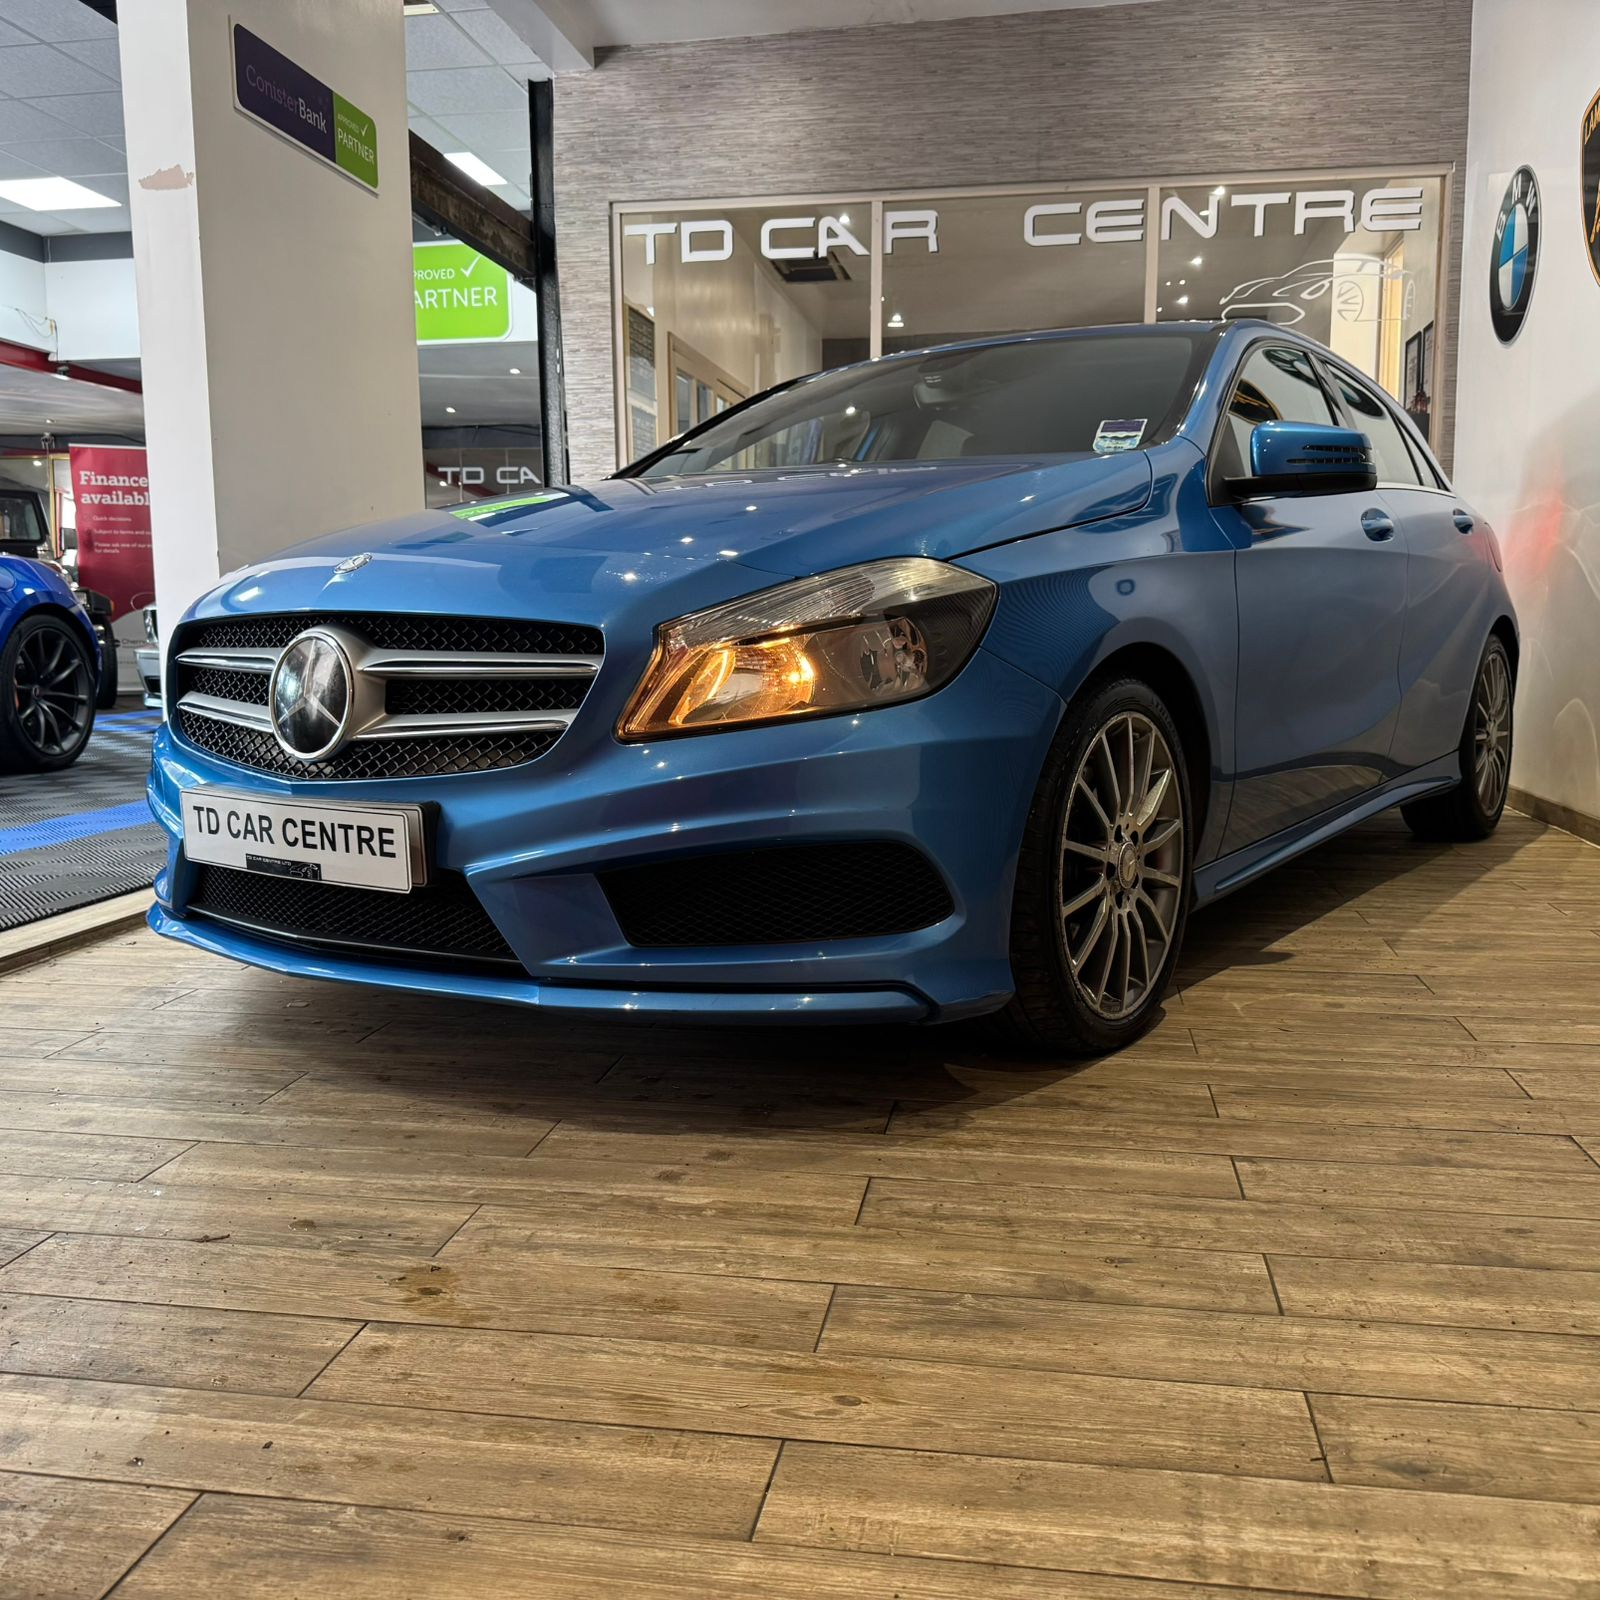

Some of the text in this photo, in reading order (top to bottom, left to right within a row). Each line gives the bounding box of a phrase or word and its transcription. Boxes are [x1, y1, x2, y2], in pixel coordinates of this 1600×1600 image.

[246, 64, 327, 134] ConisterBank
[337, 128, 375, 165] PARTNER
[624, 186, 1424, 265] TD CAR CENTRE
[1496, 172, 1536, 241] BMW
[79, 470, 149, 487] Finance
[438, 466, 485, 484] TD
[193, 805, 397, 859] TD CAR CENTRE
